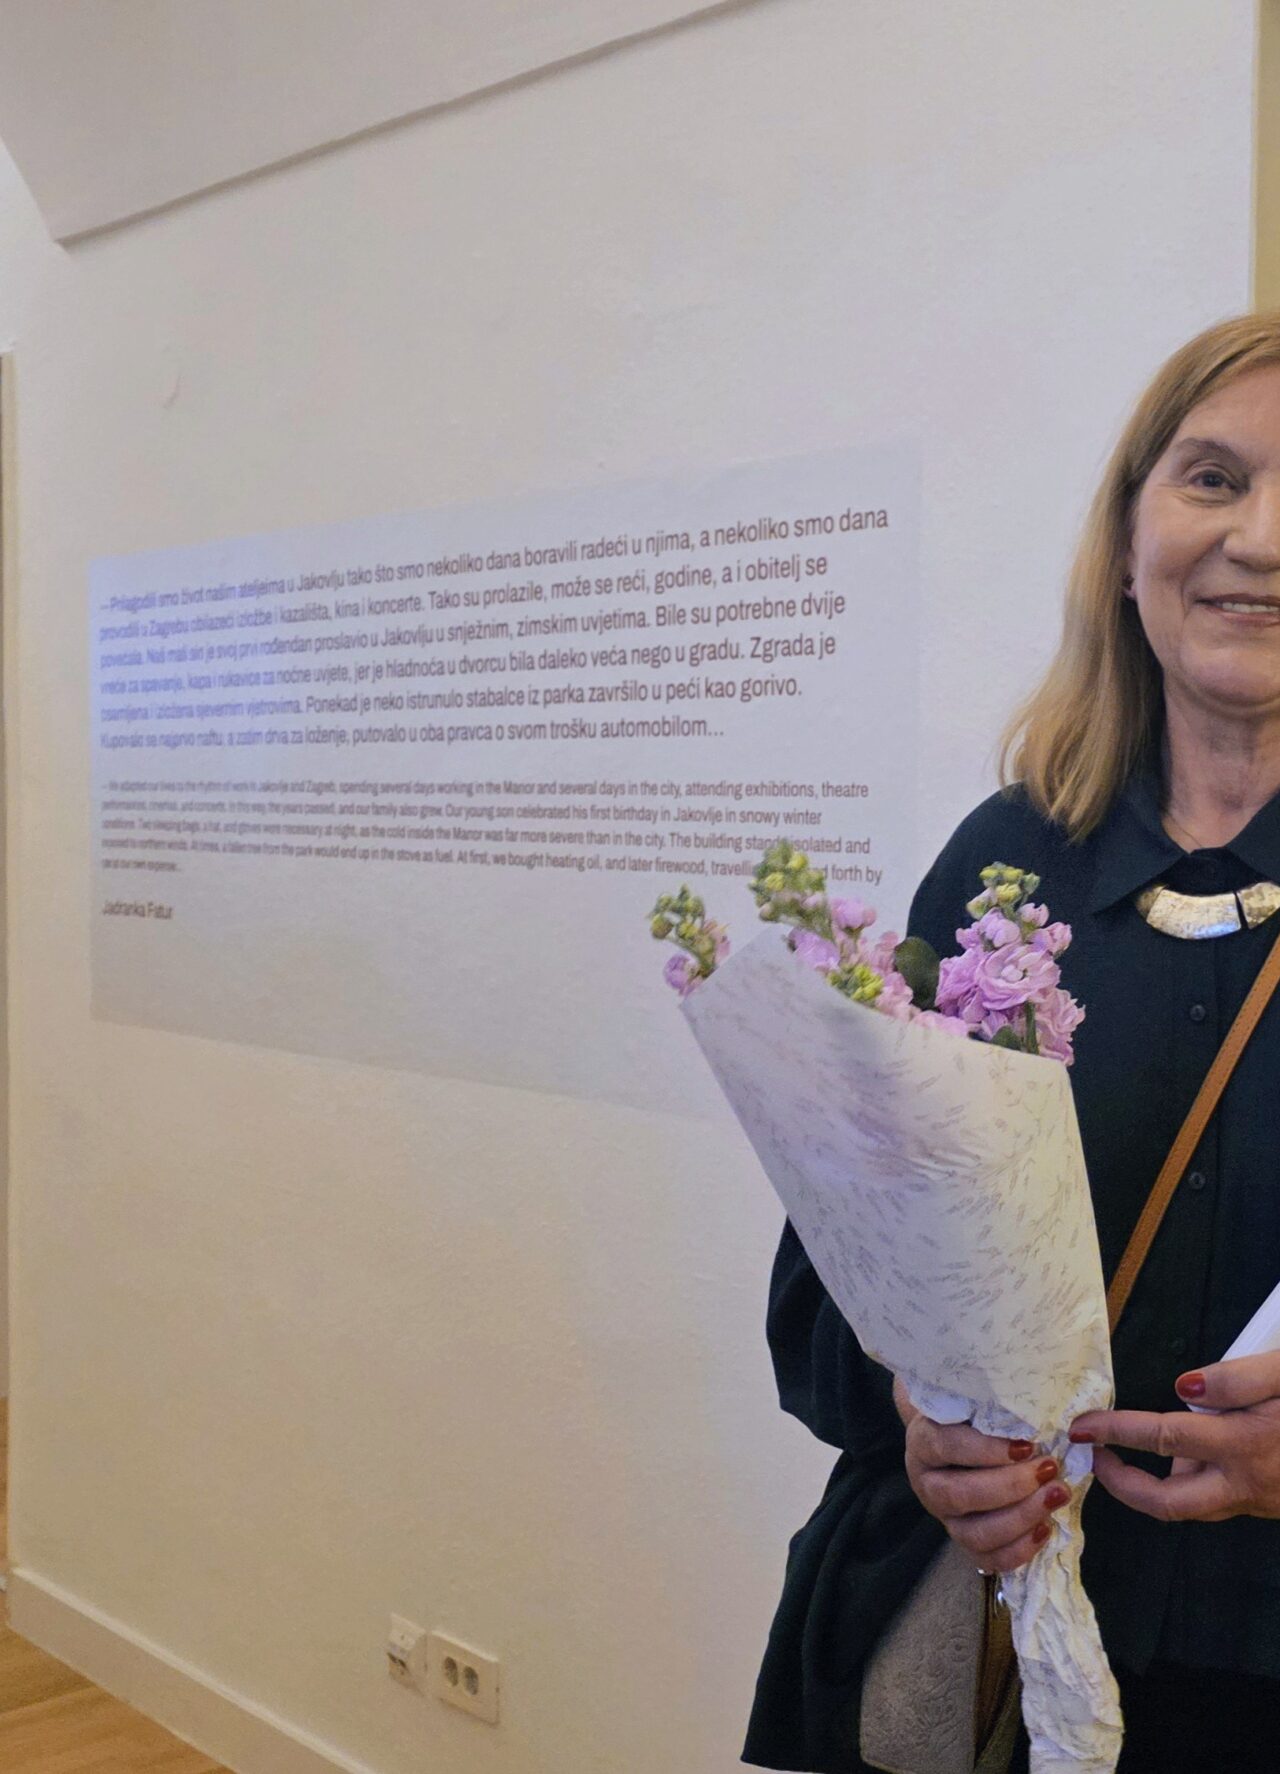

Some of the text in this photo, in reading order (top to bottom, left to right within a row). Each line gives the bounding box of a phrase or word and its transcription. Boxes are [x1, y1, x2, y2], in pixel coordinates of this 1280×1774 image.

[346, 567, 372, 585] tako
[396, 563, 424, 579] smo
[426, 554, 483, 575] nekoliko
[486, 552, 521, 570] dana
[524, 542, 576, 565] boravili
[580, 536, 628, 559] radeći
[646, 532, 695, 557] njima,
[714, 519, 789, 545] nekoliko
[794, 516, 834, 537] smo
[838, 509, 888, 532] dana
[428, 590, 460, 609] Tako
[463, 592, 480, 606] su
[483, 582, 548, 609] prolazile,
[551, 576, 591, 598] može
[594, 578, 613, 594] se
[654, 566, 717, 593] godine,
[744, 556, 800, 582] obitelj
[804, 558, 828, 575] se
[380, 625, 434, 647] Jakovlju
[516, 614, 576, 636] zimskim
[581, 609, 650, 635] uvjetima.
[656, 605, 686, 626] Bile
[690, 607, 711, 623] su
[716, 597, 796, 626] potrebne
[800, 592, 846, 619] dvije
[354, 662, 371, 683] jer
[372, 661, 384, 682] je
[458, 656, 506, 674] dvorcu
[509, 651, 535, 670] bila
[538, 648, 587, 668] daleko
[590, 645, 627, 666] veća
[630, 647, 672, 667] nego
[689, 639, 746, 666] gradu.
[750, 635, 814, 662] Zgrada
[818, 633, 836, 660] je
[360, 694, 371, 714] je
[373, 692, 404, 710] neko
[406, 689, 463, 708] istrunulo
[466, 687, 524, 706] stabalce
[527, 686, 540, 704] iz
[543, 683, 584, 708] parka
[588, 680, 648, 701] završilo
[666, 677, 700, 704] peći
[704, 678, 736, 698] kao
[740, 675, 802, 702] gorivo.
[352, 724, 406, 746] putovalo
[420, 723, 444, 740] oba
[447, 726, 492, 744] pravca
[508, 725, 547, 739] svom
[550, 718, 596, 738] trošku
[599, 780, 625, 799] days
[628, 780, 638, 796] in
[640, 780, 658, 796] the
[684, 781, 742, 801] attending
[821, 781, 869, 797] theatre
[589, 804, 611, 820] first
[612, 805, 658, 825] birthday
[660, 805, 670, 821] in
[673, 806, 723, 826] Jakovlje
[726, 807, 736, 823] in
[739, 811, 780, 828] snowy
[783, 808, 822, 825] winter
[612, 830, 623, 845] in
[624, 830, 642, 846] the
[670, 832, 690, 848] The
[694, 832, 742, 854] building
[845, 837, 870, 854] and
[605, 856, 625, 871] and
[628, 856, 652, 872] later
[832, 863, 862, 881] forth
[865, 865, 882, 886] by
